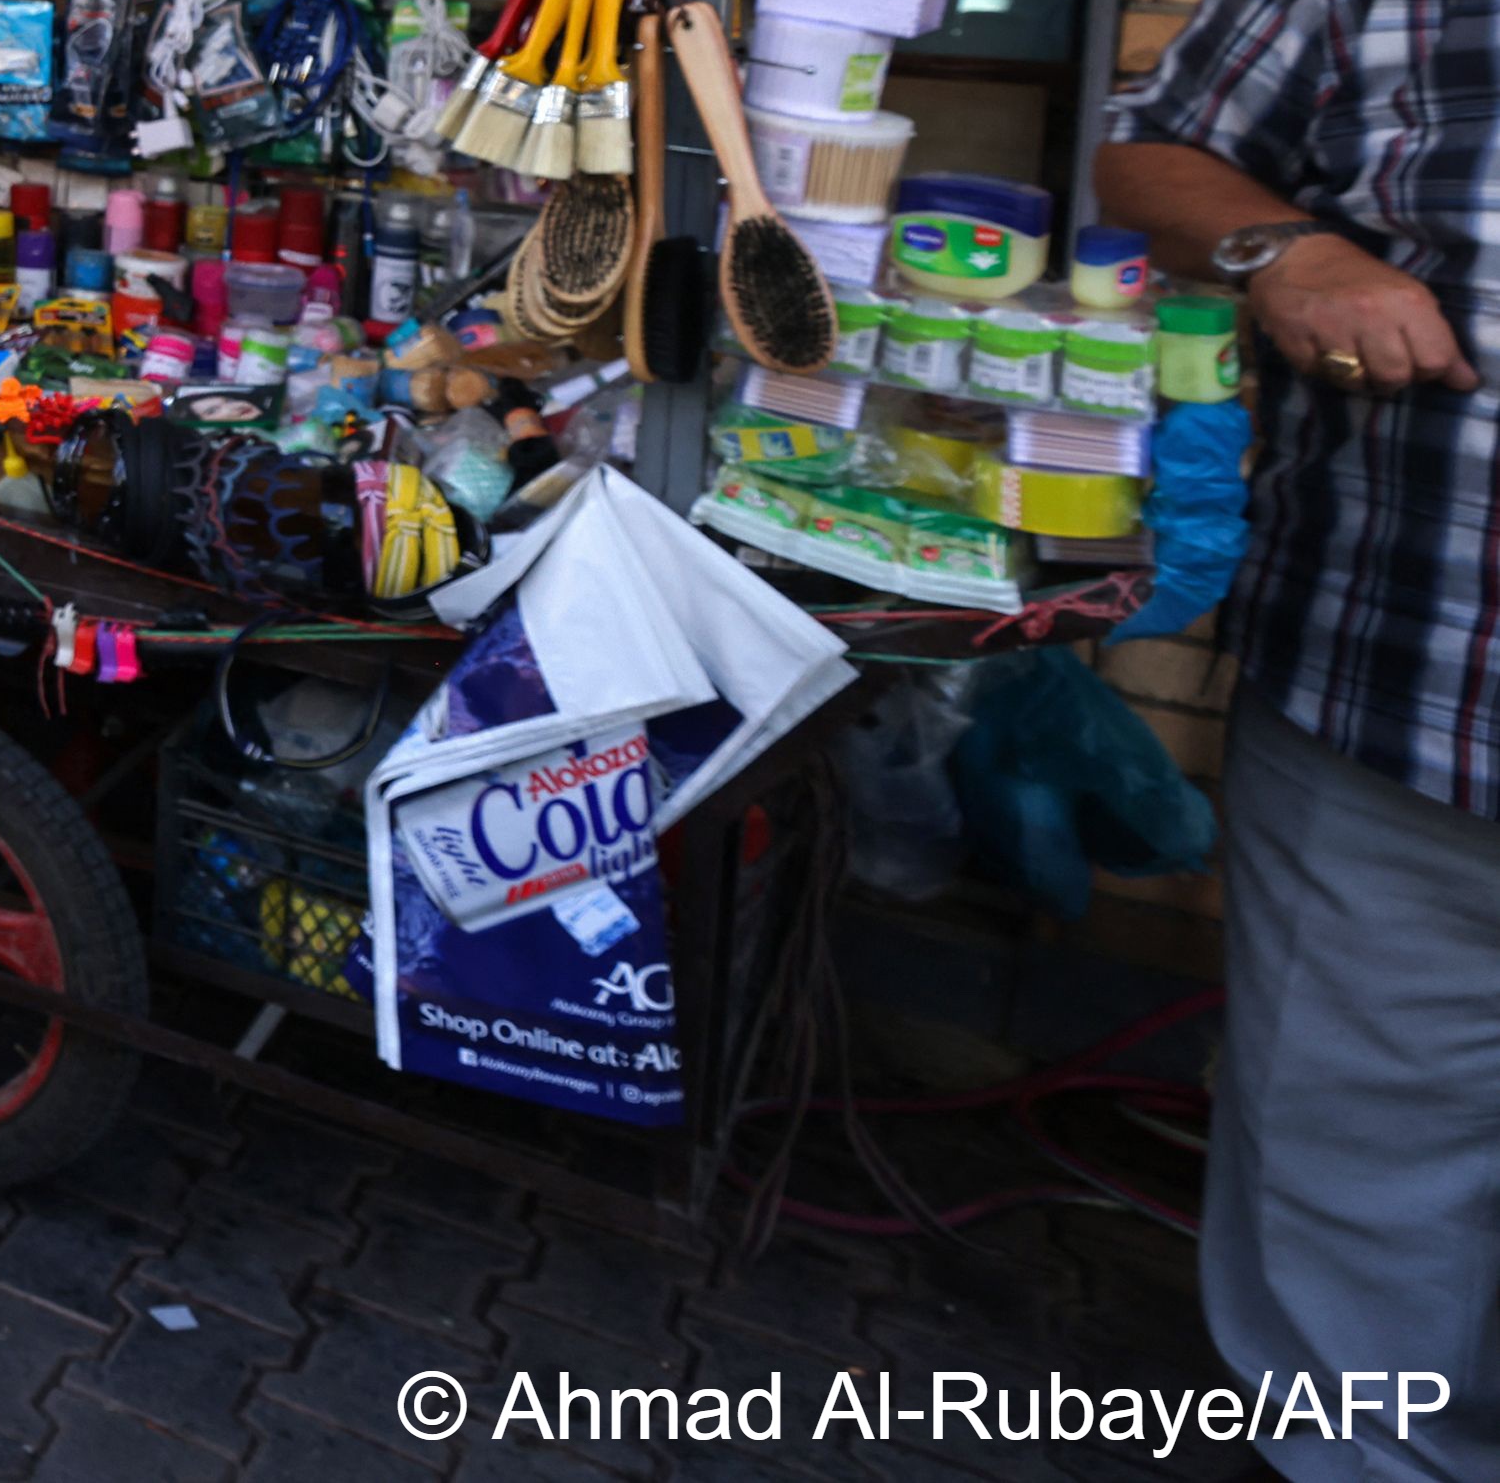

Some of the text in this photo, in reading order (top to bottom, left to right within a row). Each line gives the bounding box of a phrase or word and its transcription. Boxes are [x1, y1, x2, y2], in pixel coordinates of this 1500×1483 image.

[471, 762, 655, 881] Cola
[432, 825, 487, 887] light
[418, 1001, 489, 1042] Shop
[491, 1018, 586, 1061] Online
